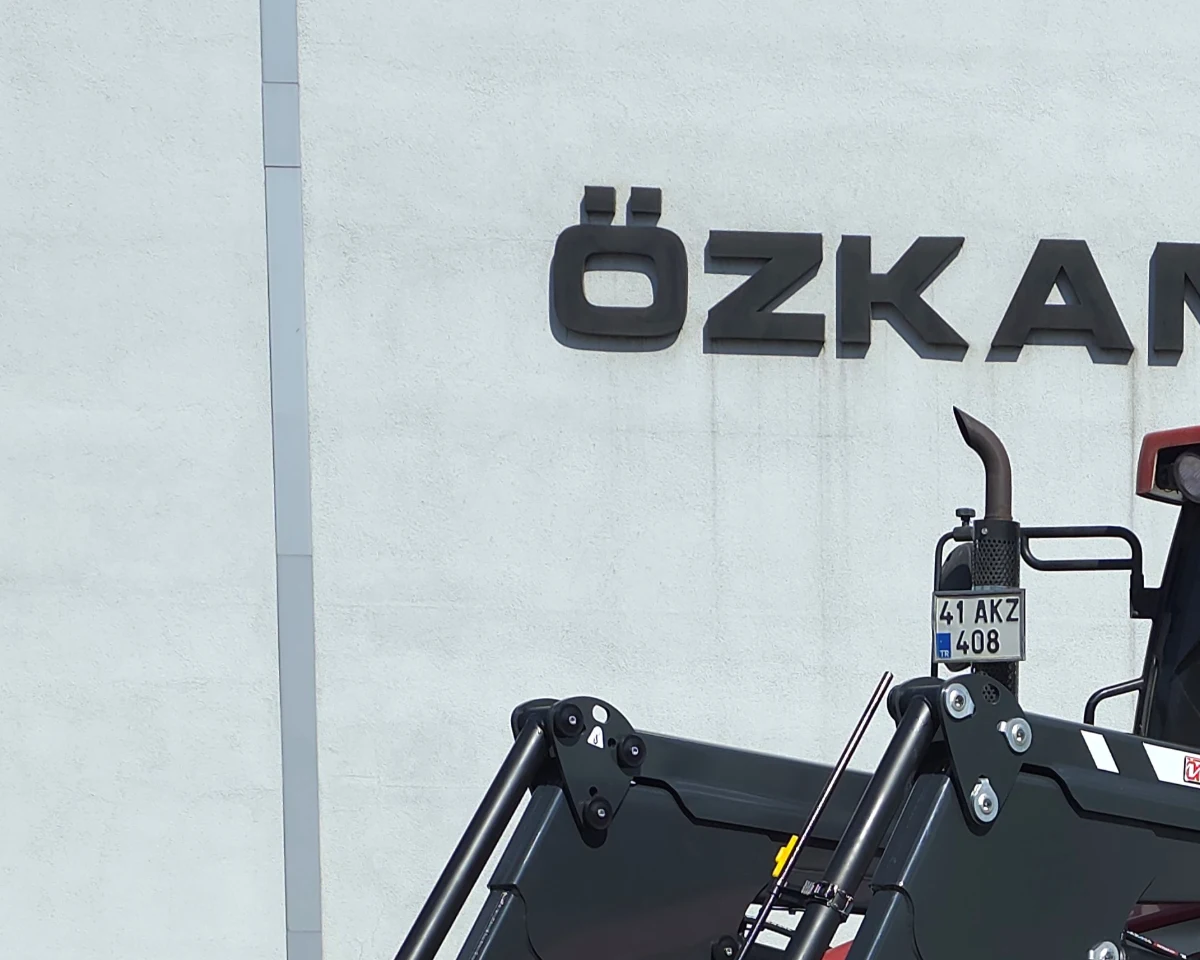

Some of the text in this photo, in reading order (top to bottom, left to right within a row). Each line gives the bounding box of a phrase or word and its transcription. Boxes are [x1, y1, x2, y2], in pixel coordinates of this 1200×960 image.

[940, 598, 1019, 625] 41 AKZ
[956, 629, 1000, 655] 408
